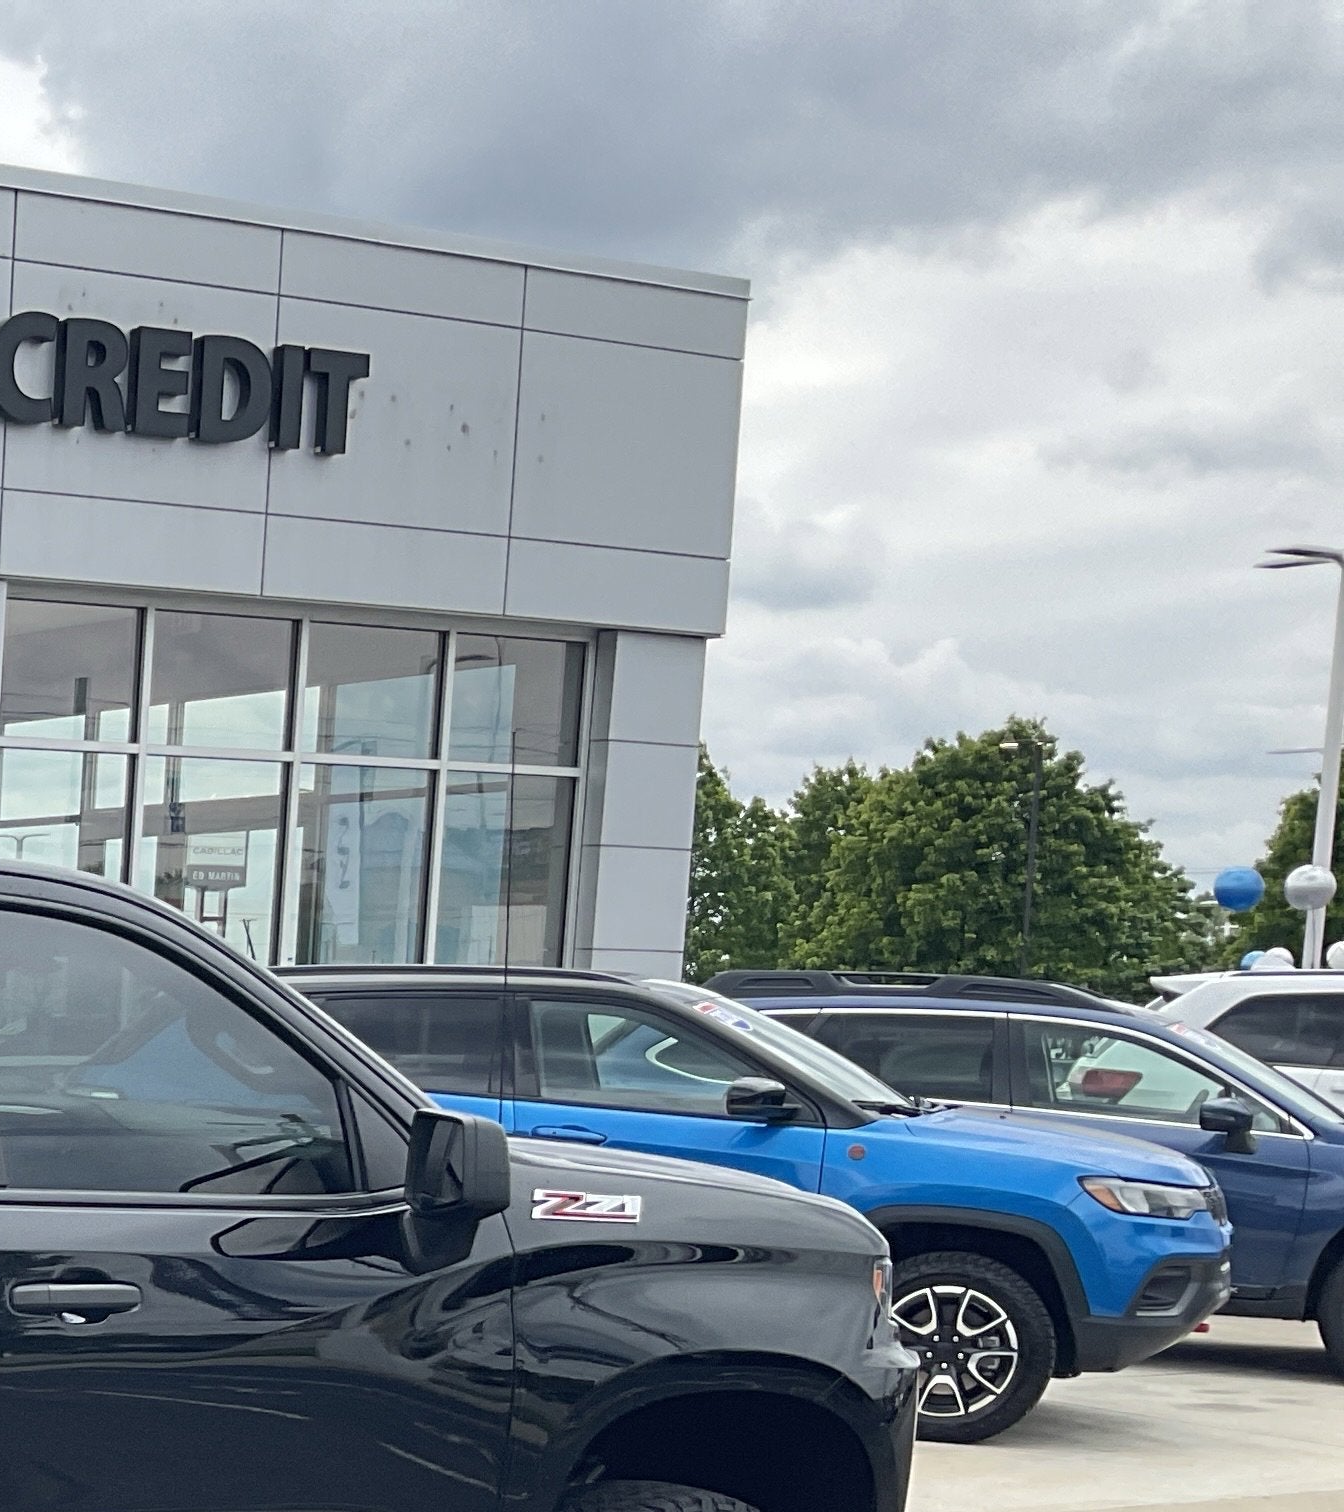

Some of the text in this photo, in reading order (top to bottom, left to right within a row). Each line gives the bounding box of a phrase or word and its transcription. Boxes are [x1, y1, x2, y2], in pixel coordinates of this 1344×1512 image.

[192, 847, 244, 856] CADILLAC
[192, 870, 241, 881] ED MARTIN
[530, 1188, 642, 1224] Z71
